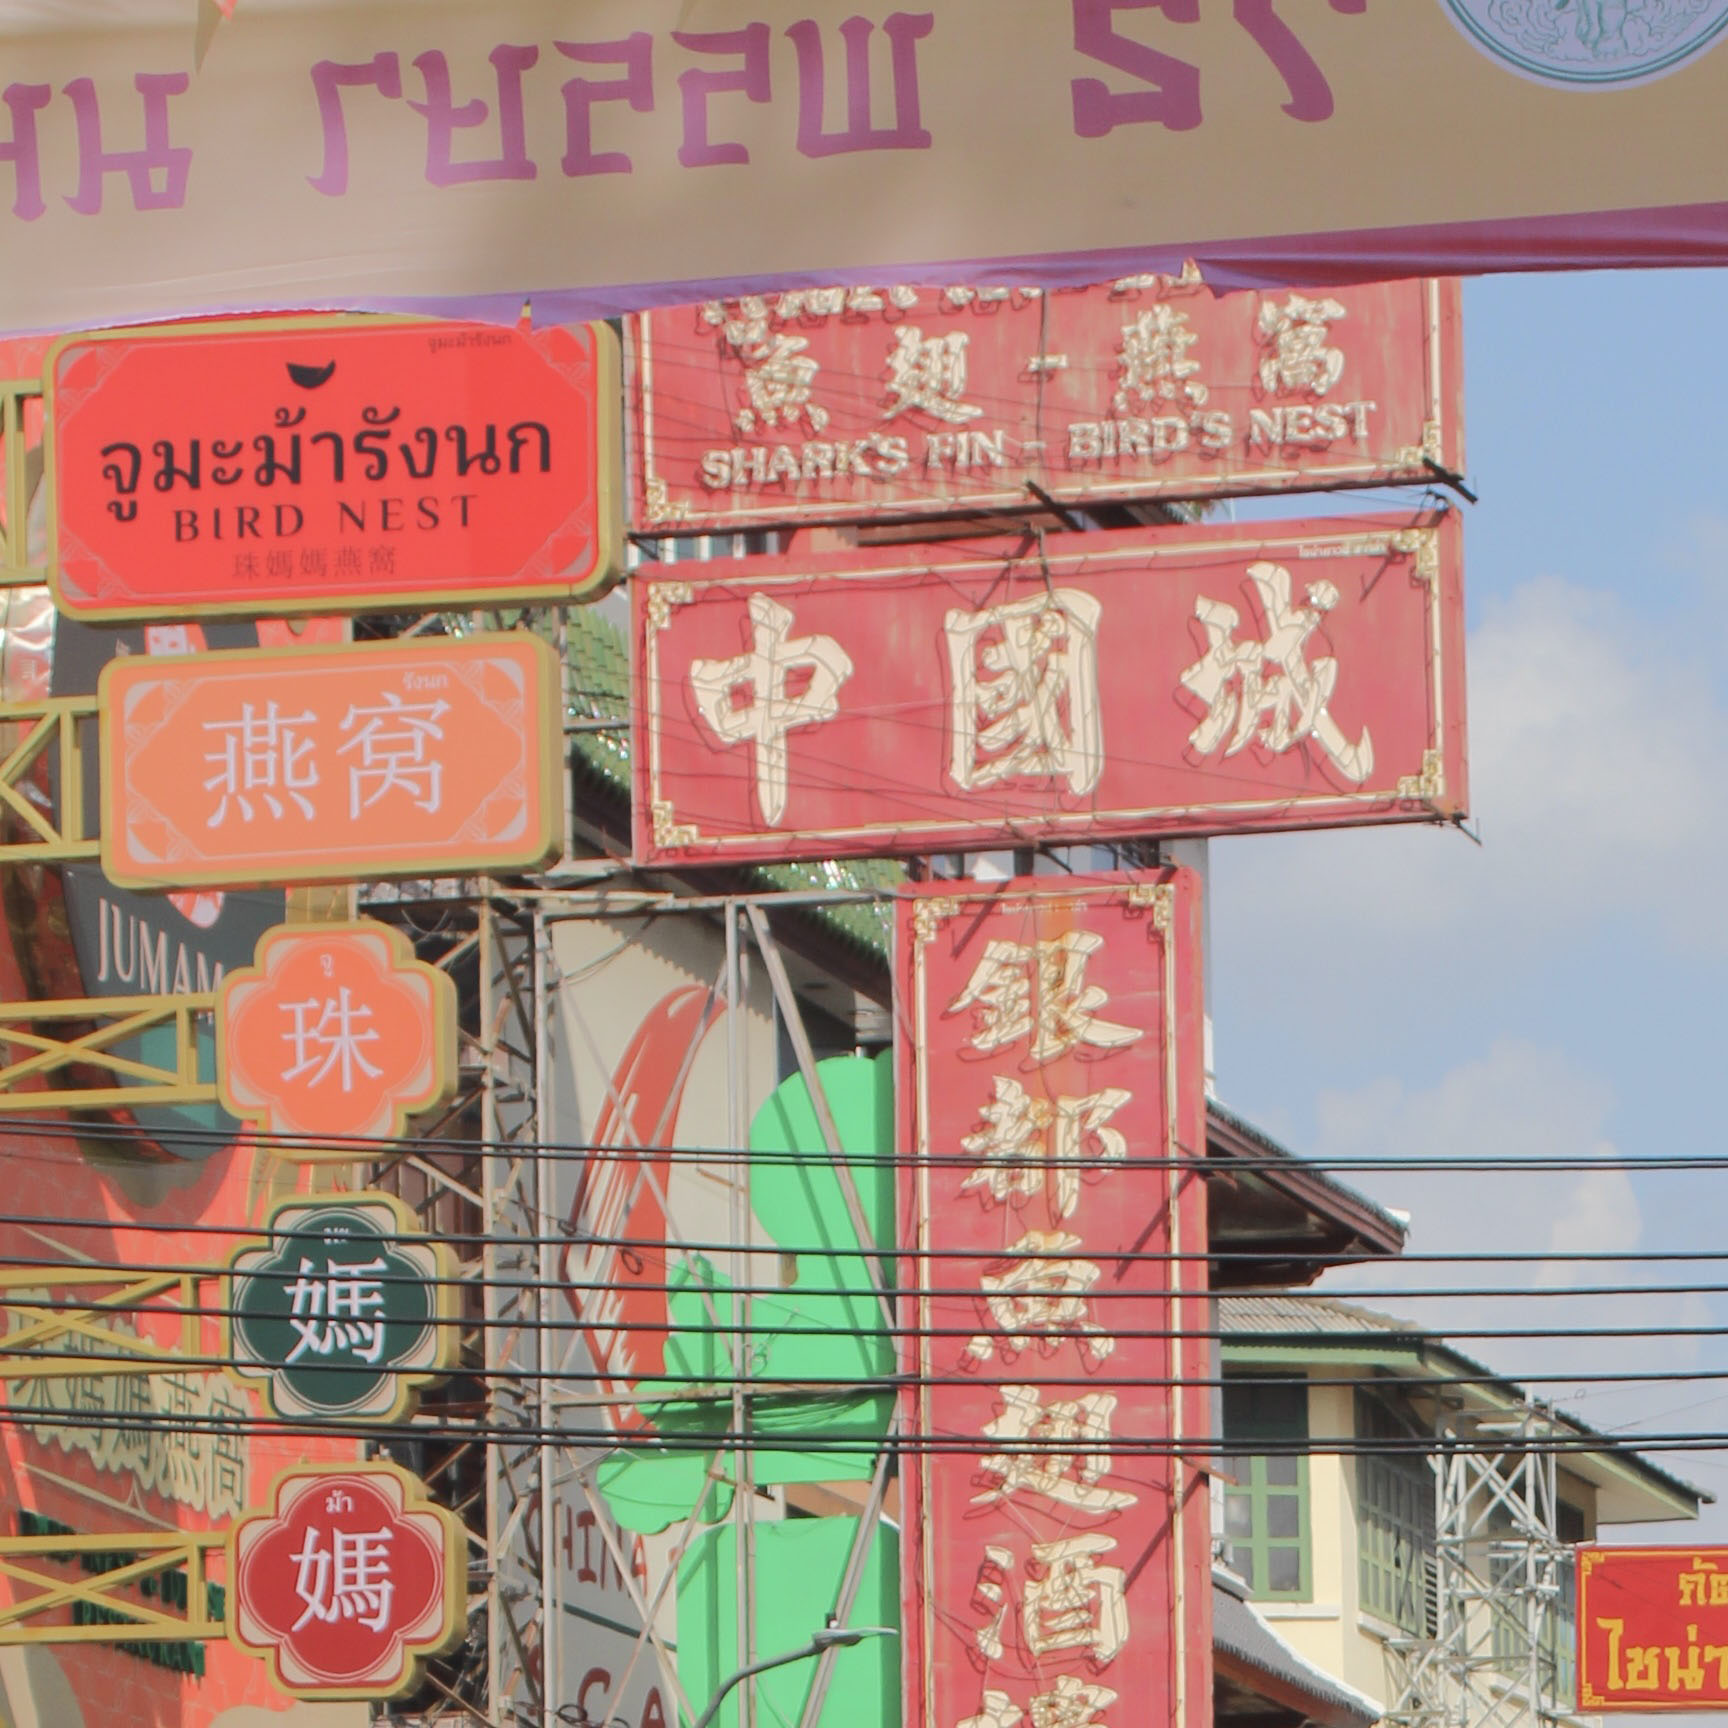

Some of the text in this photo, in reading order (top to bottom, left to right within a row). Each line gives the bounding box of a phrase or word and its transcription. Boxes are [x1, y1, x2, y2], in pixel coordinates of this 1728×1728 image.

[100, 405, 552, 524] จูมะม้ารังนก
[701, 432, 909, 490] SHARK'S
[926, 428, 1005, 471] FIN
[1067, 411, 1234, 461] BIRD'S
[1248, 399, 1377, 448] NEST
[173, 493, 479, 543] BIRD NEST
[689, 561, 1375, 828] 中國城
[278, 985, 384, 1093] 珠
[283, 1257, 388, 1366] 媽
[289, 1526, 394, 1633] 媽
